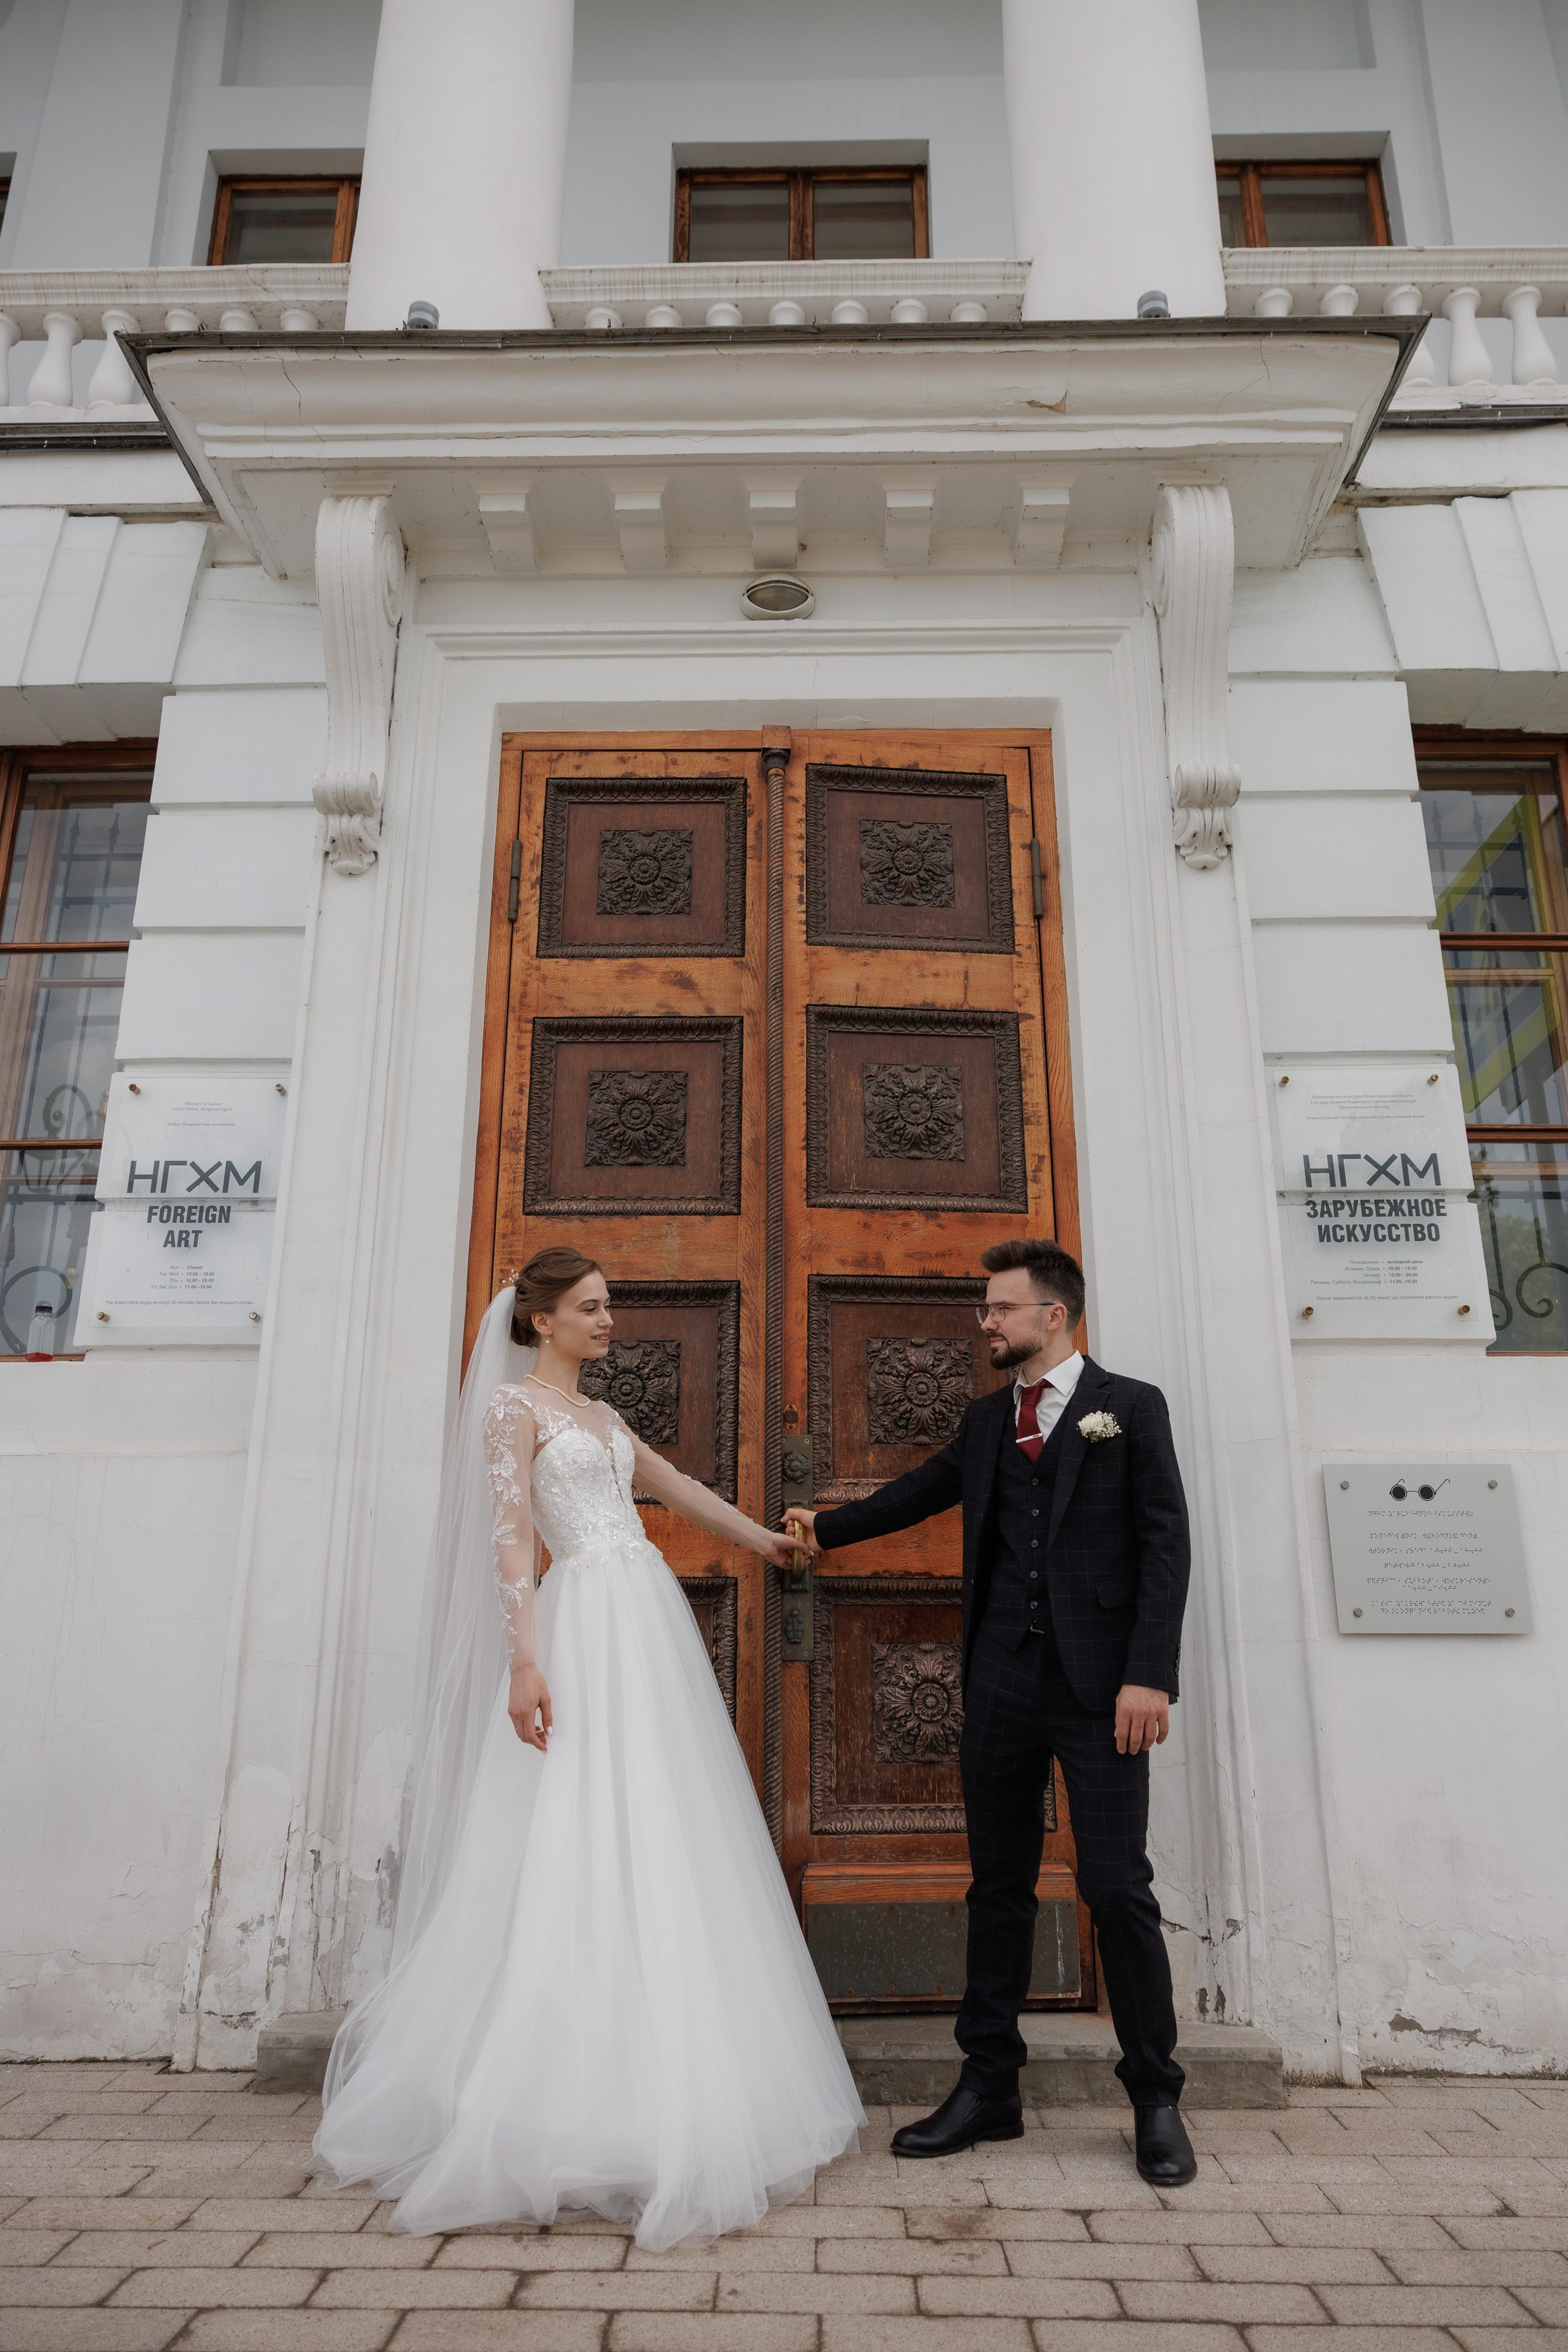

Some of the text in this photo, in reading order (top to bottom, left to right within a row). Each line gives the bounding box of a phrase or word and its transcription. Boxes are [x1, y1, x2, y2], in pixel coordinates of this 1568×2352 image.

[126, 1160, 262, 1193] НГХМ
[1303, 1153, 1442, 1188] НГХМ
[146, 1205, 232, 1224] FOREIGN
[1305, 1198, 1447, 1219] ЗАРУБЕЖНОЕ
[162, 1230, 203, 1248] ART
[1317, 1223, 1441, 1243] ИСКУССТВО
